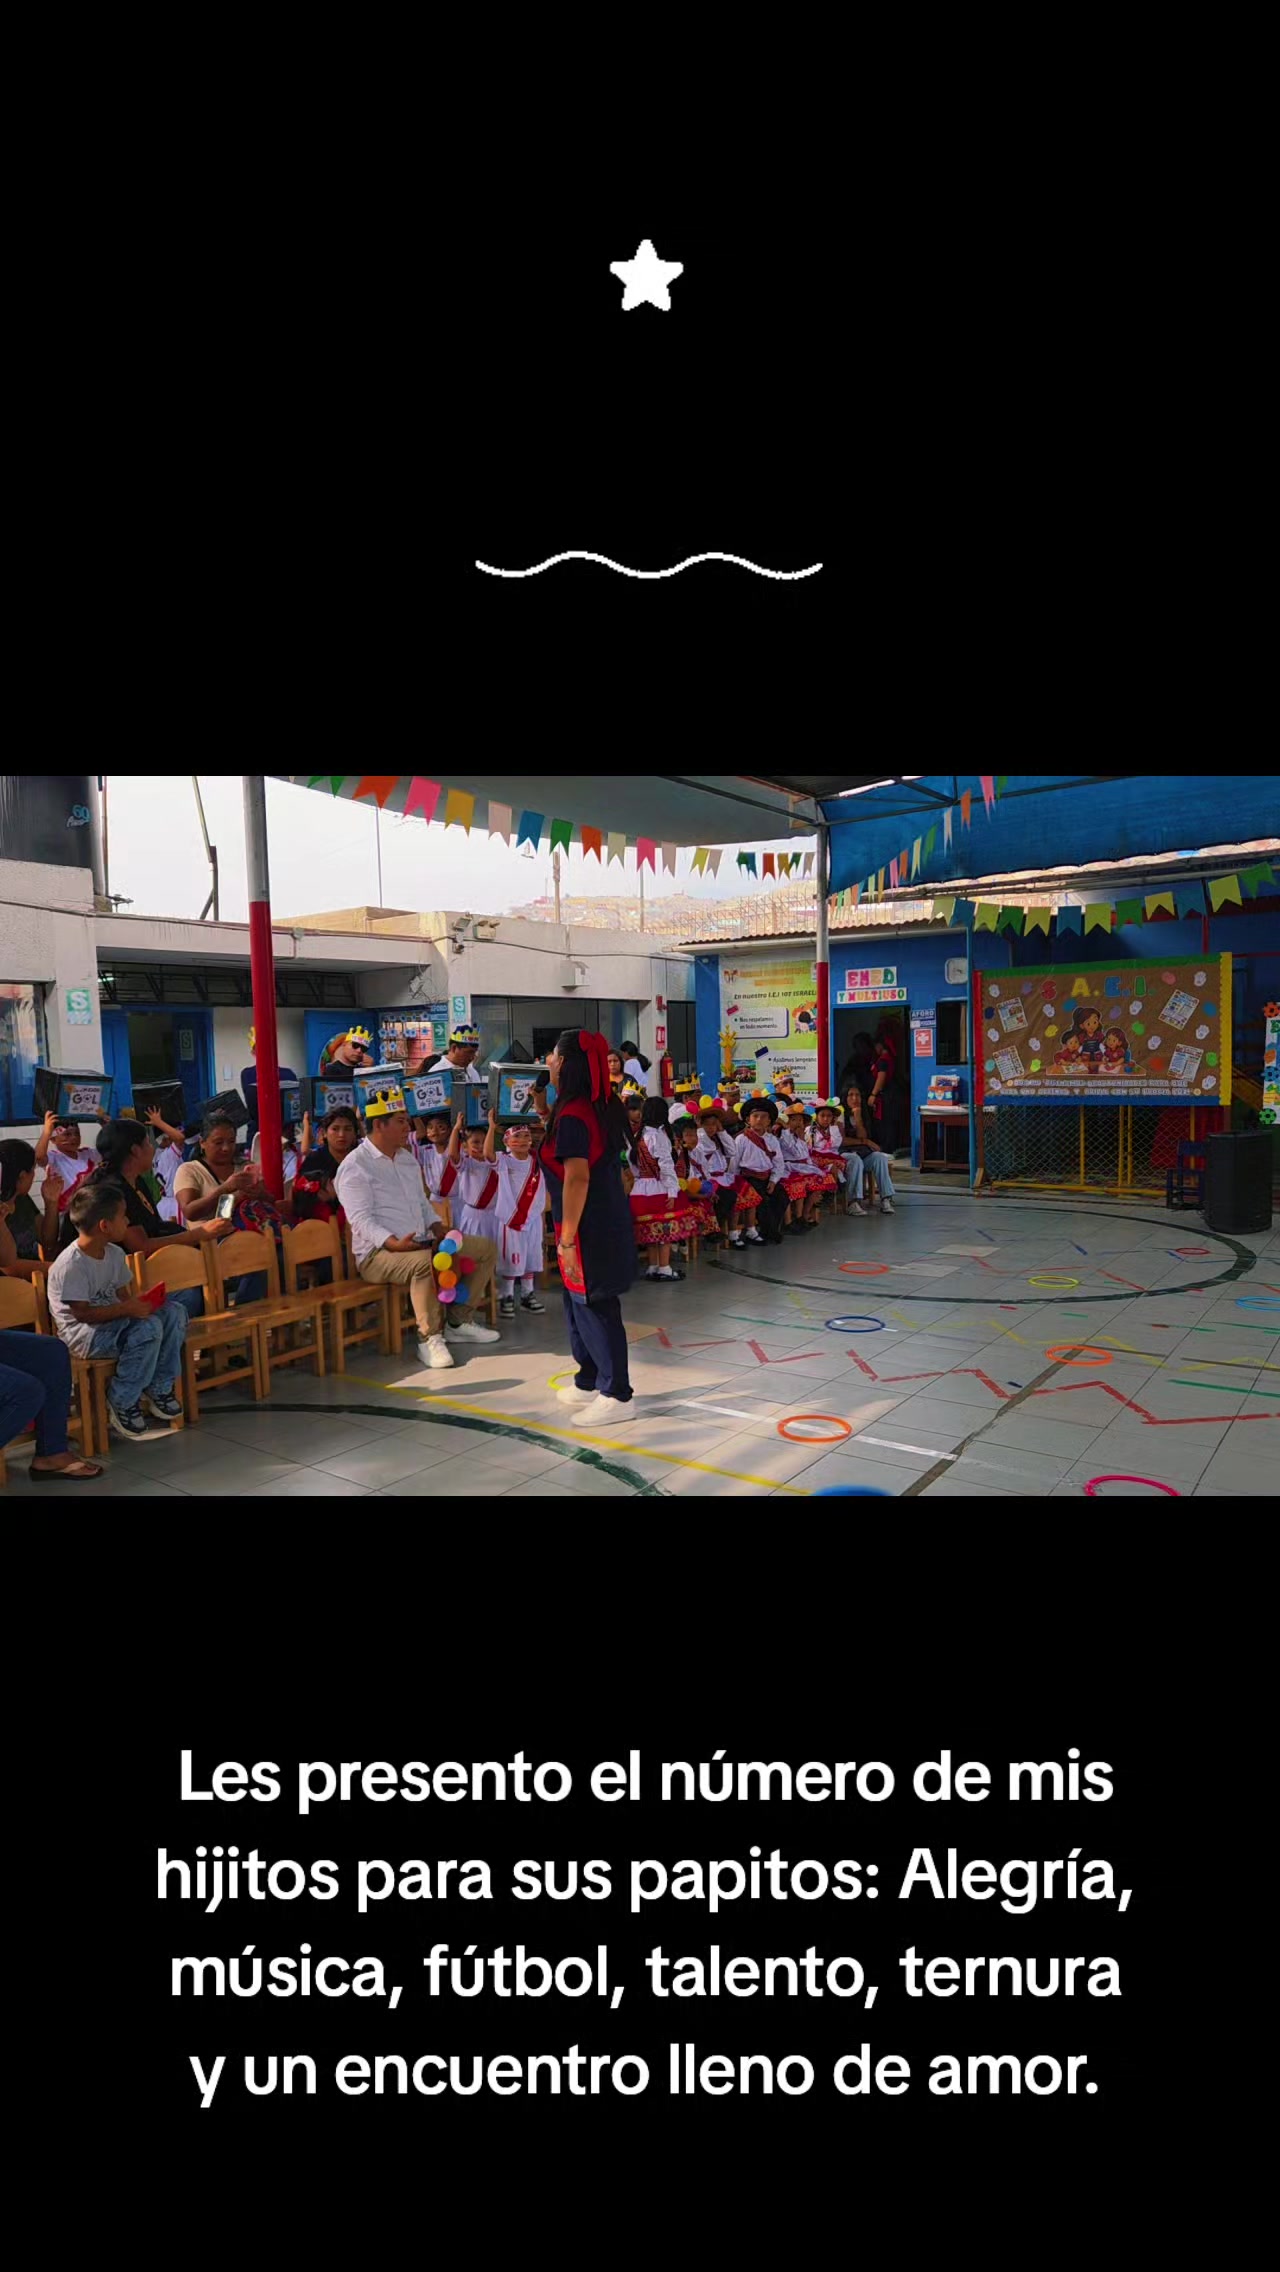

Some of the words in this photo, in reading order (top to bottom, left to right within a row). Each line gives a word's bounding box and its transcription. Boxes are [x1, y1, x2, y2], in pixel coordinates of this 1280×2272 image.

[70, 991, 87, 1010] S
[848, 989, 905, 1002] MULTIUSO
[455, 998, 465, 1012] S
